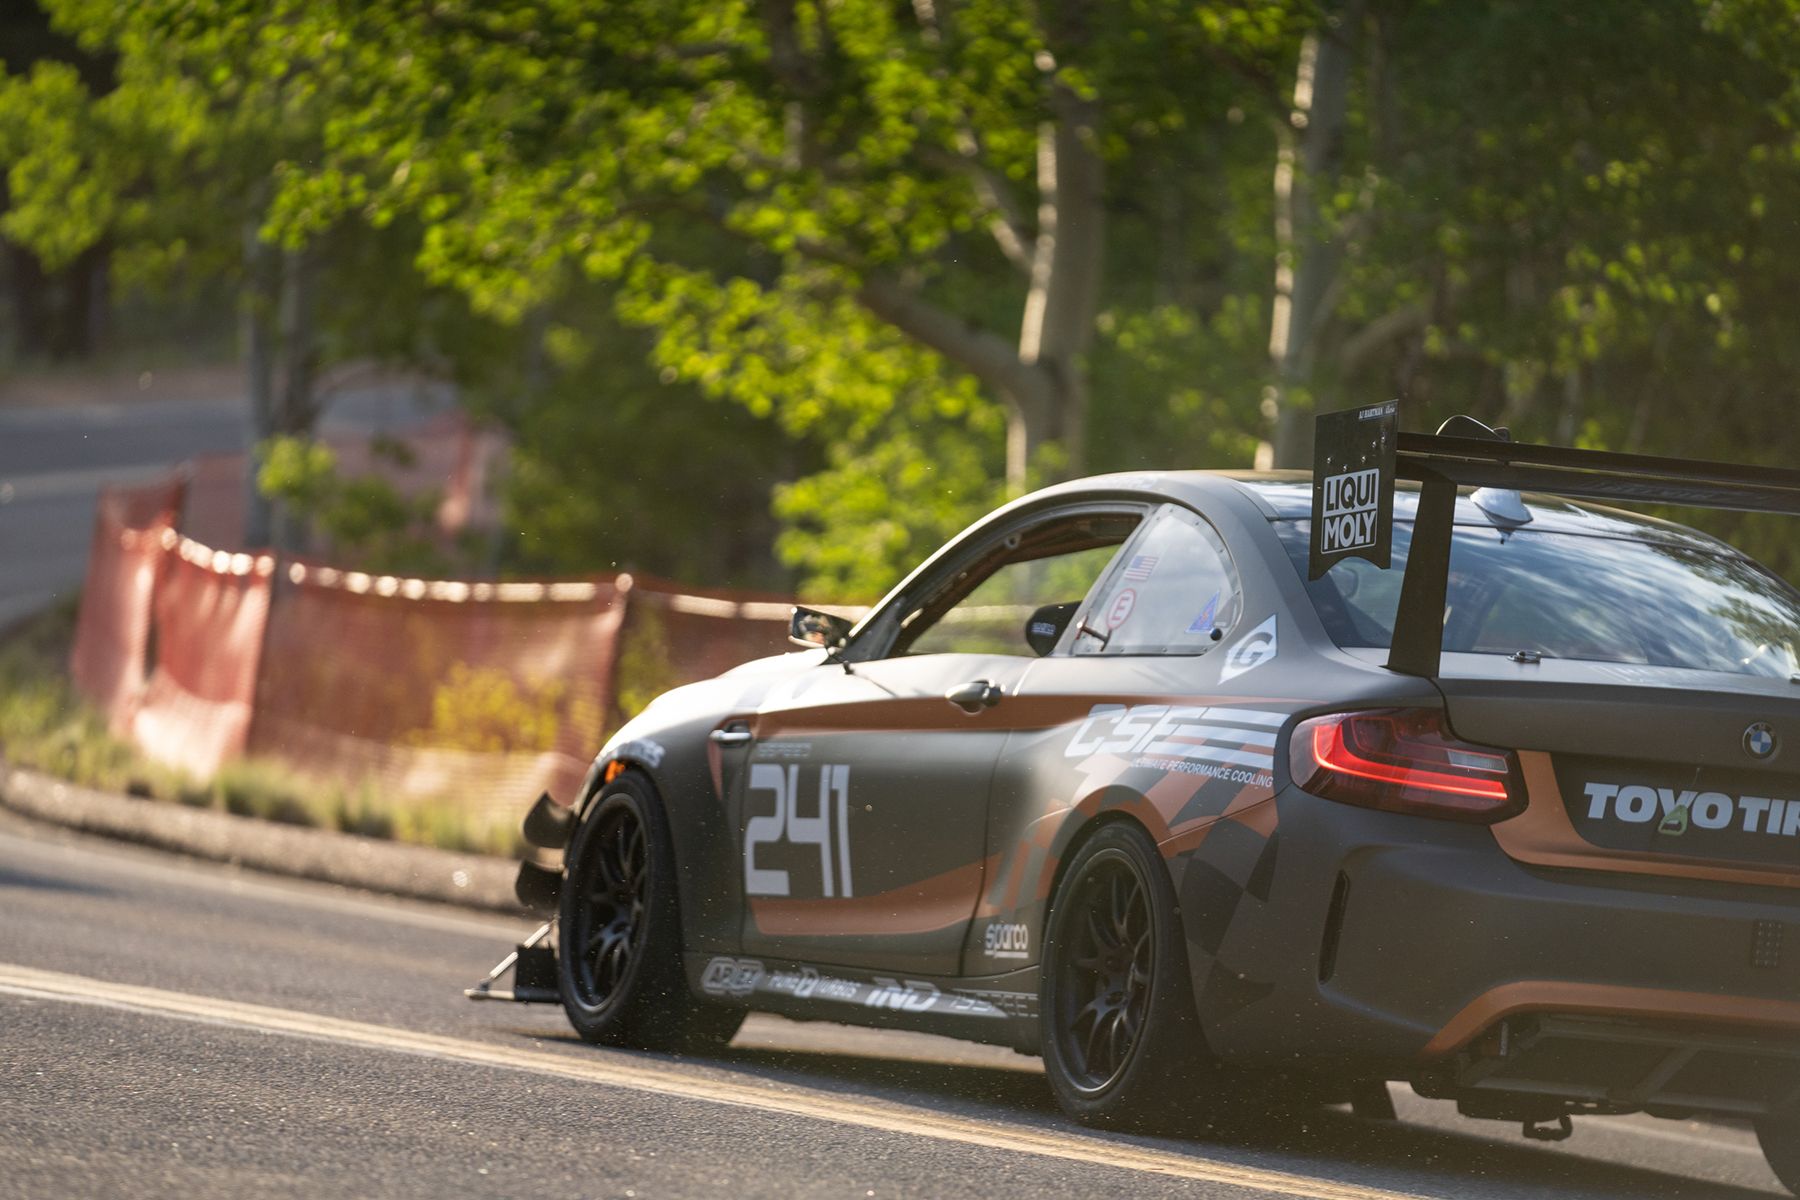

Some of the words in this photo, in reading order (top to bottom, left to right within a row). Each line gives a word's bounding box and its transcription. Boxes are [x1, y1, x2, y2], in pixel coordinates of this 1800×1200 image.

[1326, 473, 1377, 512] LIQUI
[1324, 511, 1376, 550] MOLY
[1111, 597, 1130, 621] E
[1230, 632, 1273, 670] G
[1166, 760, 1231, 781] PERFORMANCE
[1231, 769, 1274, 788] COOLING
[1584, 782, 1733, 830] TOYO
[744, 763, 853, 897] 241
[985, 924, 1028, 958] sparco
